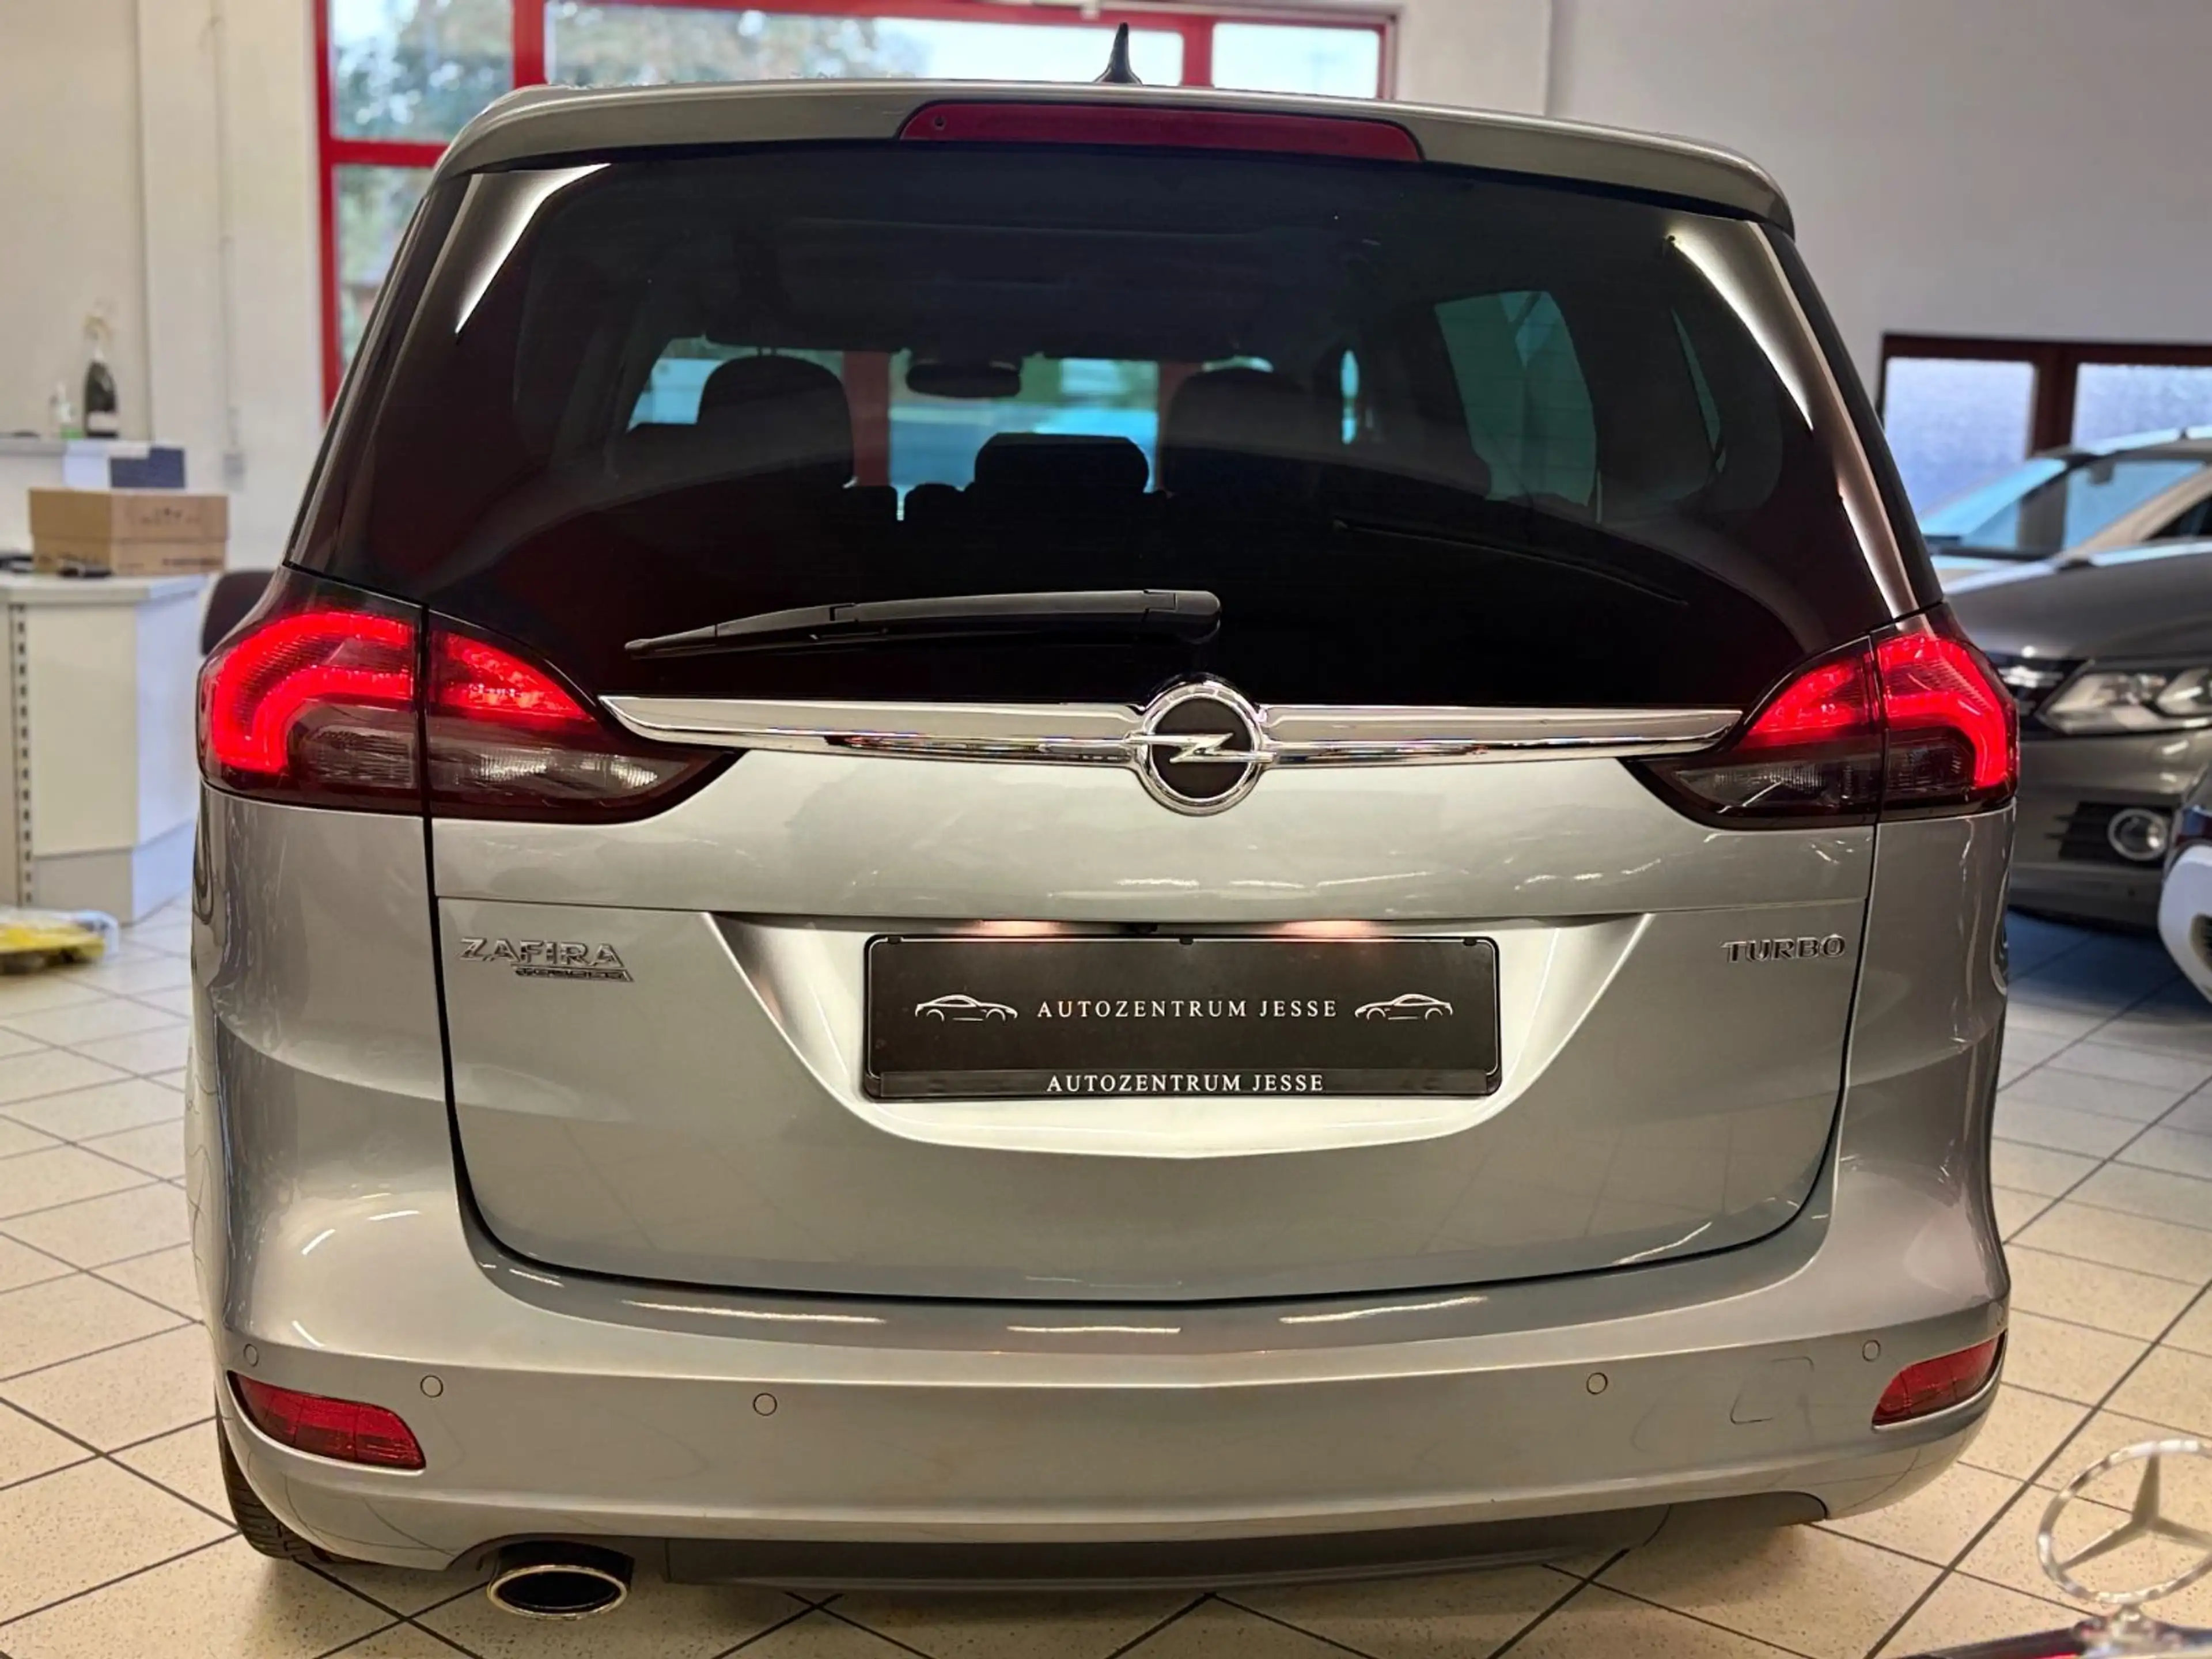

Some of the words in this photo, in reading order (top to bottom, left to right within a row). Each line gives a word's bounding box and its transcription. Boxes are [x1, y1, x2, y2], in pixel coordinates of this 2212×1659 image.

[459, 937, 624, 968] ZAFIRA
[1721, 934, 1846, 963] TURBO
[1037, 1000, 1246, 1017] AUTOZENTRUM
[1256, 1000, 1336, 1017] JESSE
[1046, 1074, 1241, 1092] AUTOZENTRUM
[1252, 1074, 1324, 1092] JESSE
